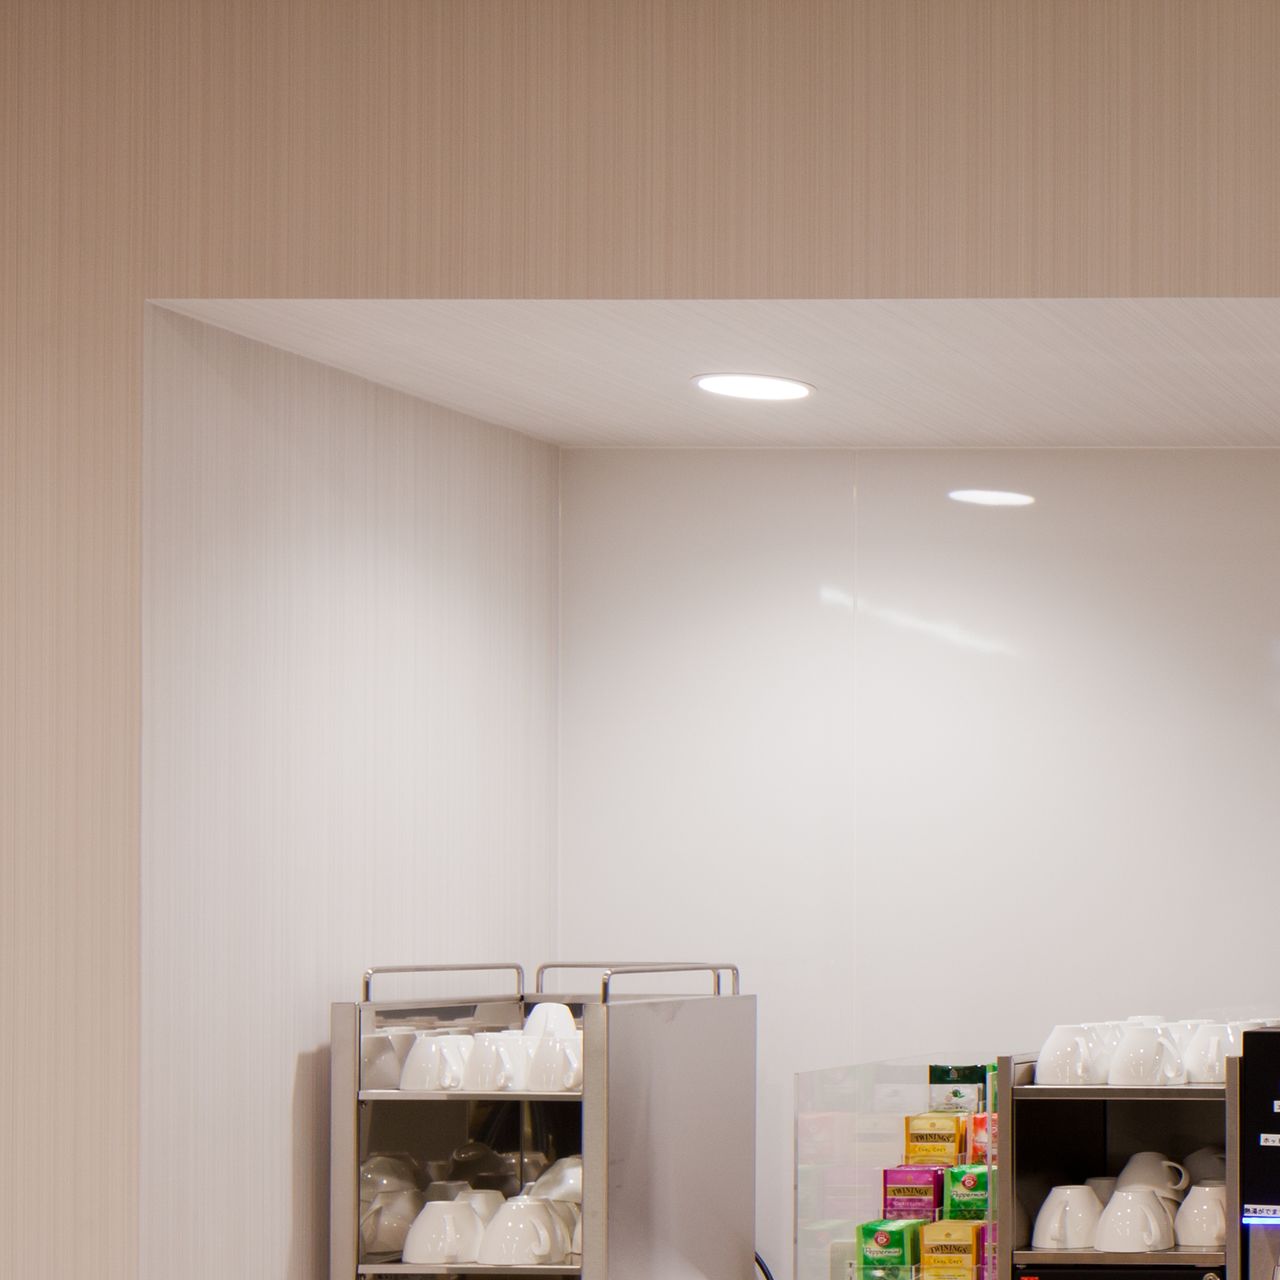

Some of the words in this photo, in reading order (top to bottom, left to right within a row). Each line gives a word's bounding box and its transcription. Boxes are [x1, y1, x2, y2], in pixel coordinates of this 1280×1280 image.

[915, 1133, 953, 1143] TWININGS
[892, 1187, 929, 1197] TWININGS
[952, 1190, 987, 1202] Peppermint
[864, 1247, 901, 1257] Peppermint
[929, 1243, 968, 1254] TWININGS
